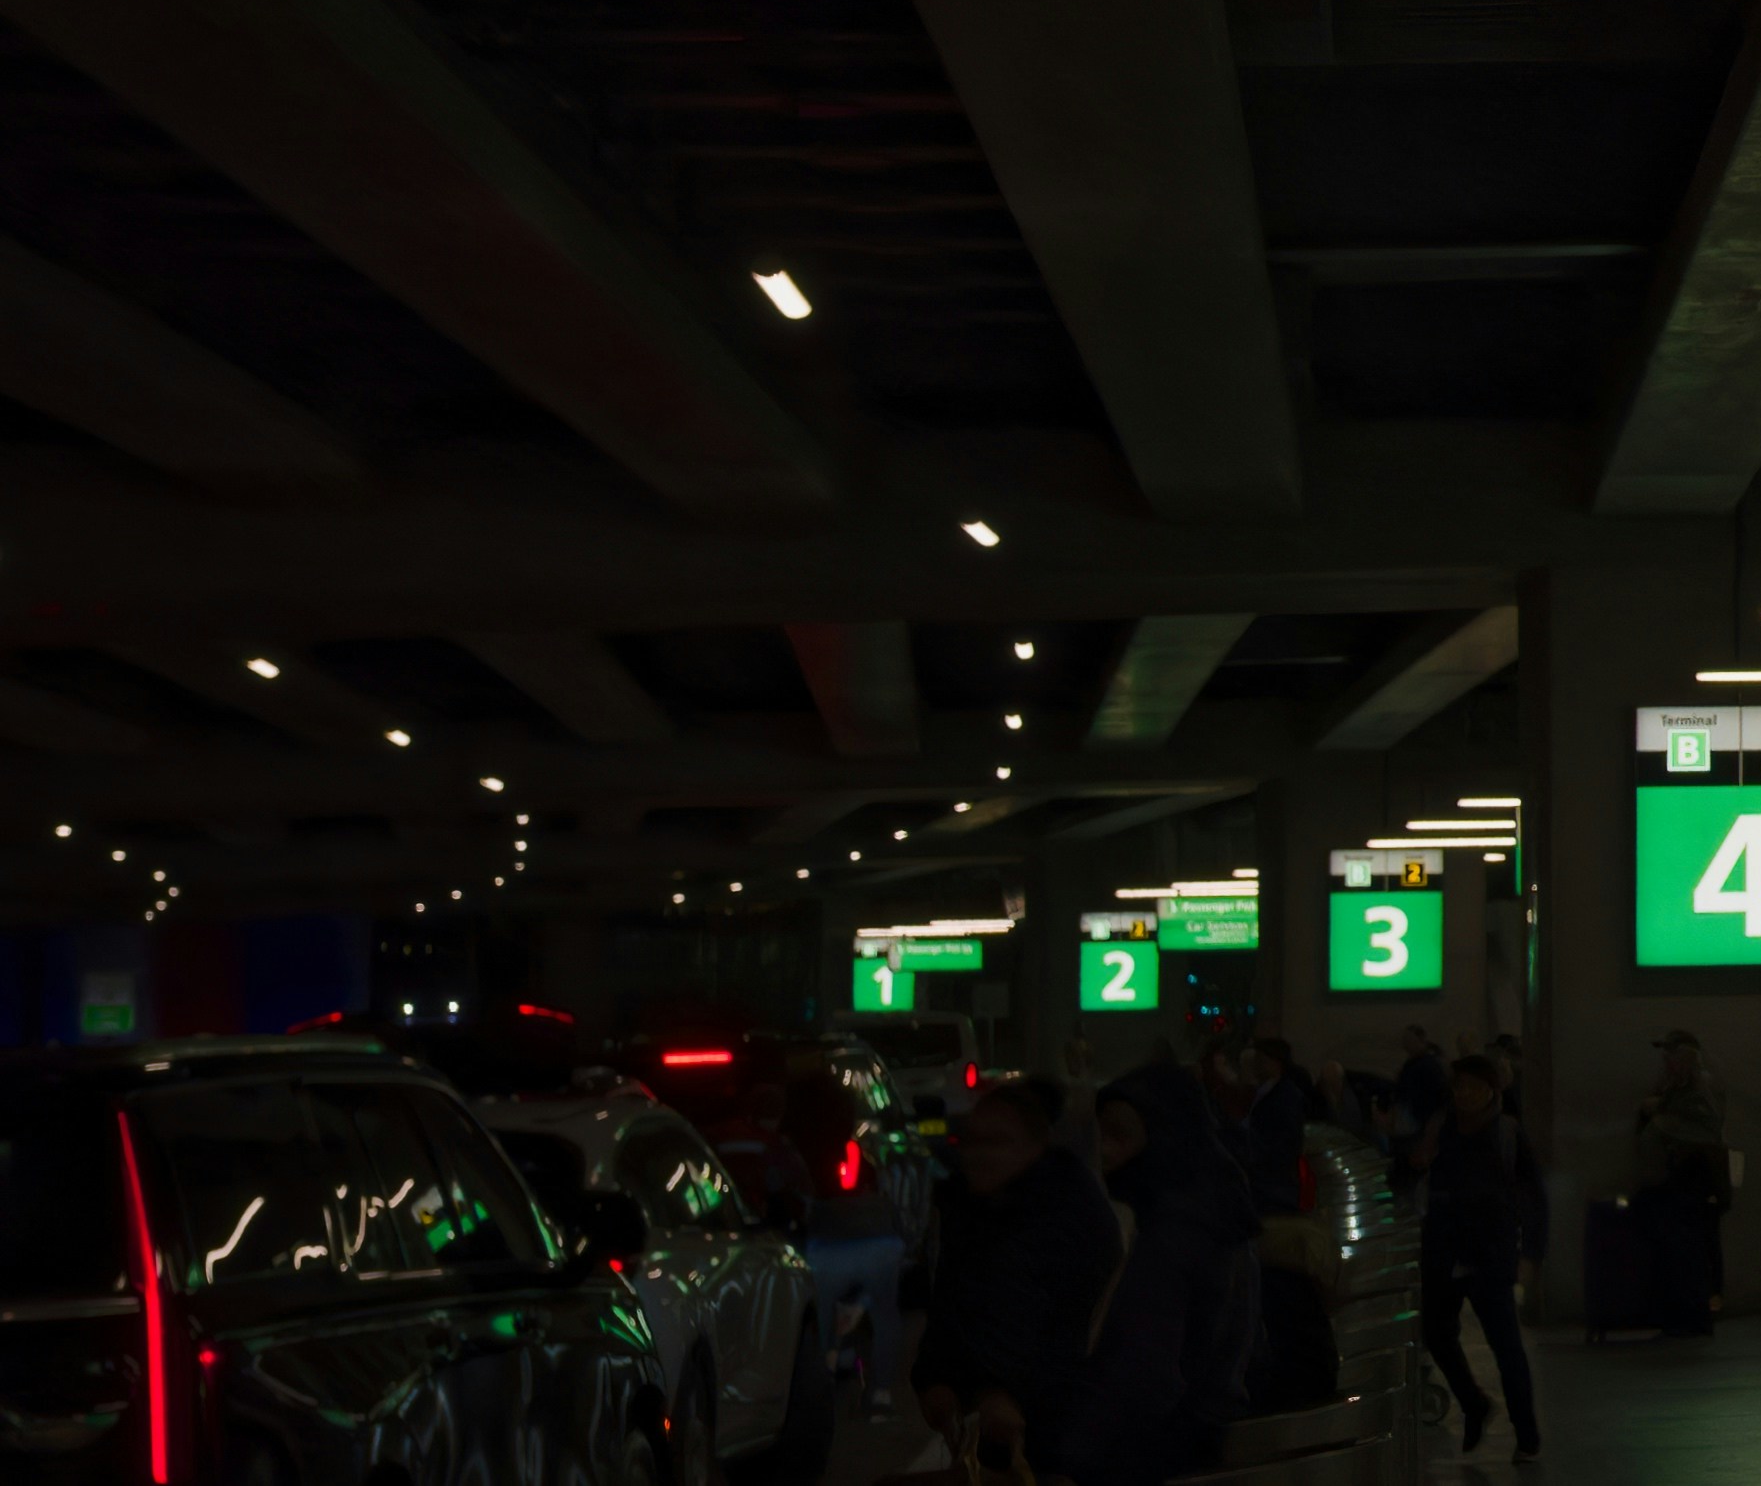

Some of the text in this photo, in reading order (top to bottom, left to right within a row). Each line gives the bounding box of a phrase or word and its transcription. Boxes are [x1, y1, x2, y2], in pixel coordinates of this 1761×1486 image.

[1661, 714, 1718, 726] Terminal
[1677, 735, 1700, 765] B
[1407, 862, 1421, 883] 2
[1362, 905, 1409, 977] 3
[873, 965, 894, 1005] 1
[1101, 950, 1136, 1001] 2
